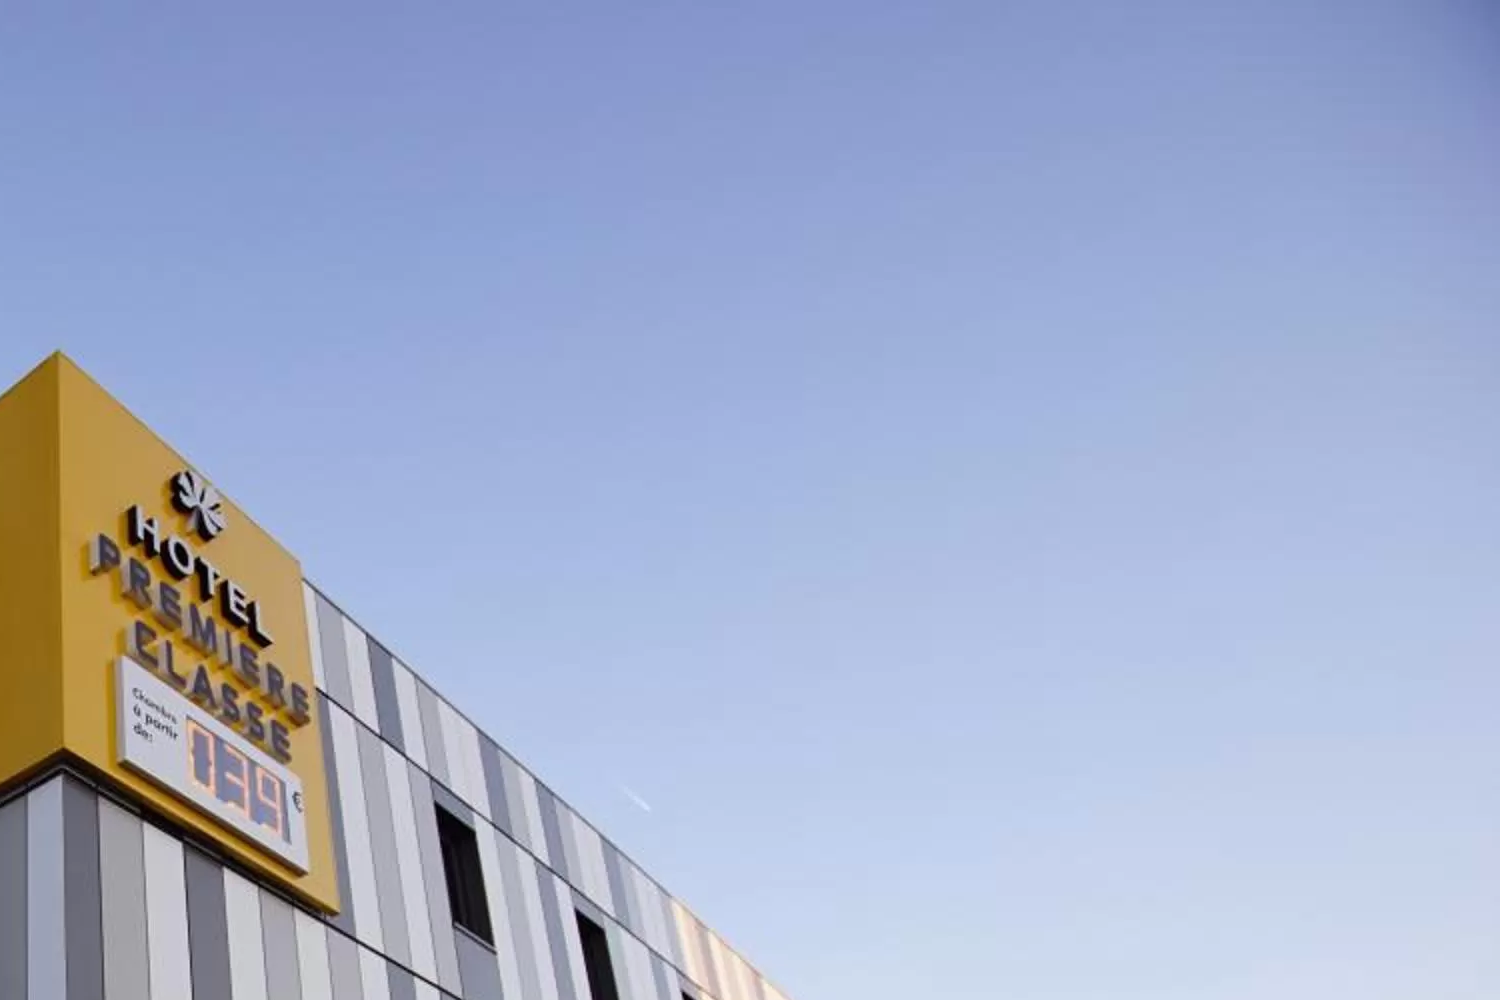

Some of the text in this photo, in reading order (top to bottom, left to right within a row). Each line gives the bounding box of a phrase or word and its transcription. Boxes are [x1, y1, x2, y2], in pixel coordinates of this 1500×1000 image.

[128, 504, 274, 648] HOTEL
[126, 619, 293, 764] CLASSE
[145, 713, 180, 741] partir
